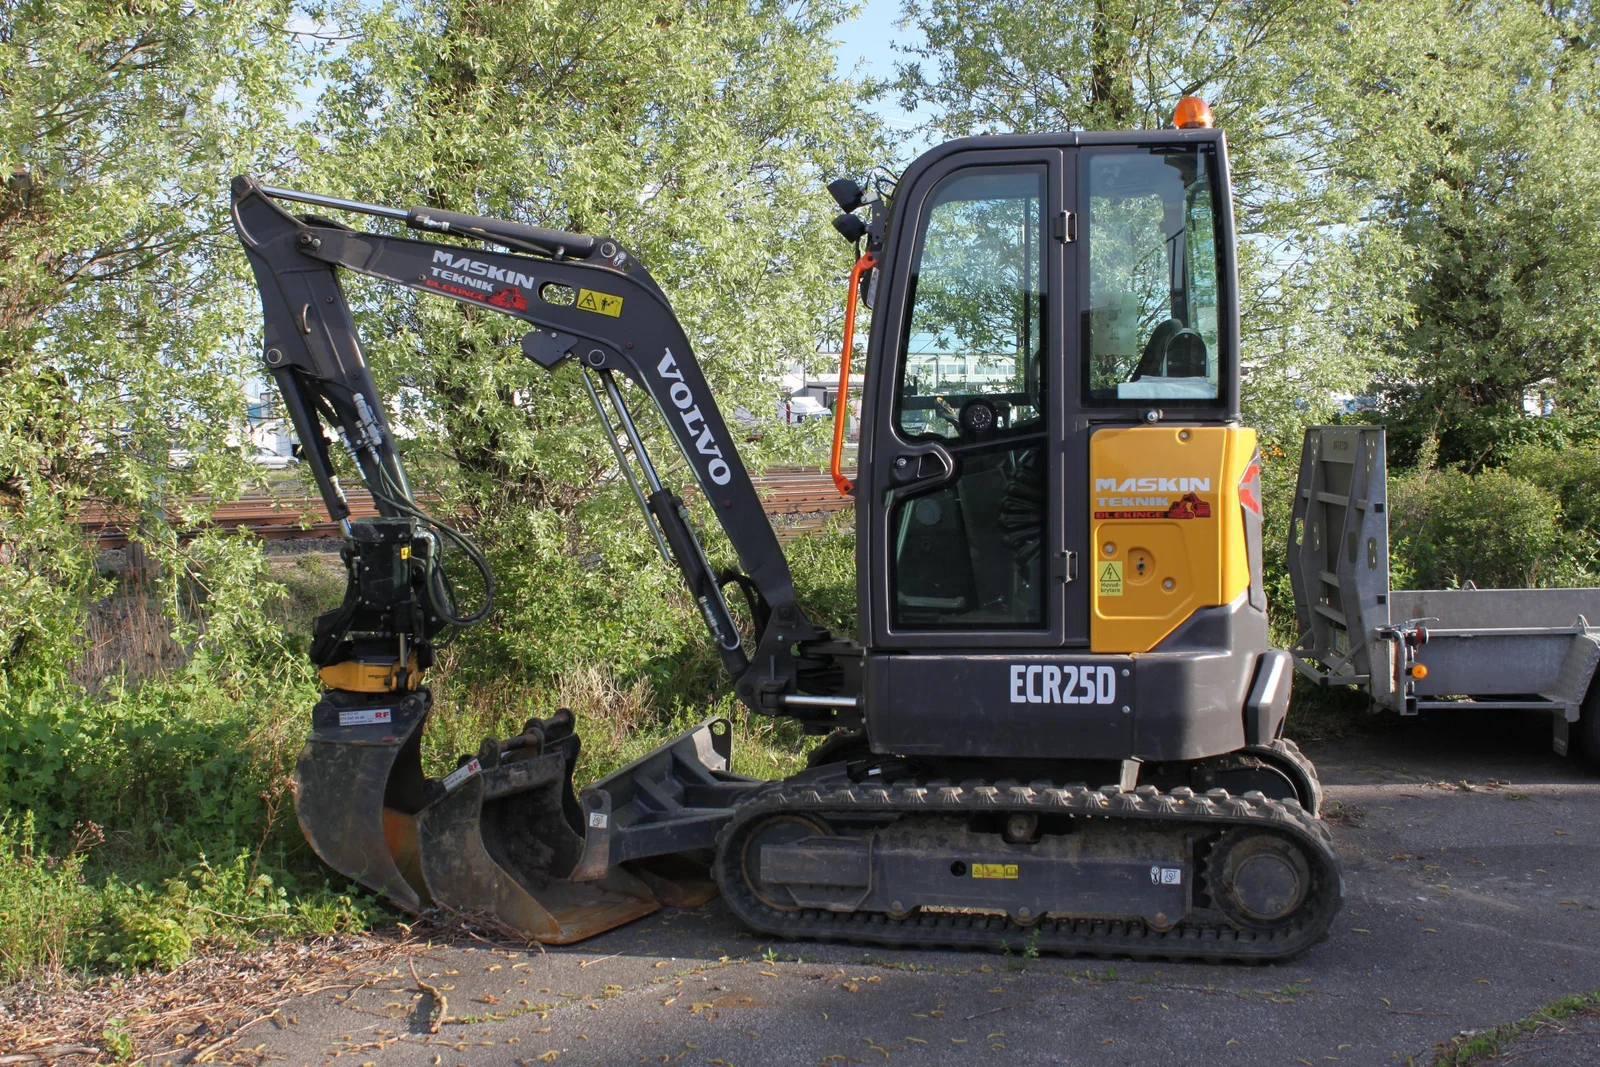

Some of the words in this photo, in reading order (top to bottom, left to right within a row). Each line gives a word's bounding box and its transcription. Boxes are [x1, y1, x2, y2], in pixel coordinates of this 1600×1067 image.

[432, 250, 535, 290] MASKIN
[430, 266, 495, 293] TEKNIK
[425, 279, 486, 301] BLEKINGE
[657, 347, 731, 486] VOLVO
[1095, 477, 1210, 492] MASKIN
[1096, 496, 1169, 507] TEKNIK
[1095, 511, 1165, 519] BLEKINGE
[1010, 664, 1116, 704] ECR25D
[375, 711, 390, 719] RF
[467, 761, 479, 773] RF
